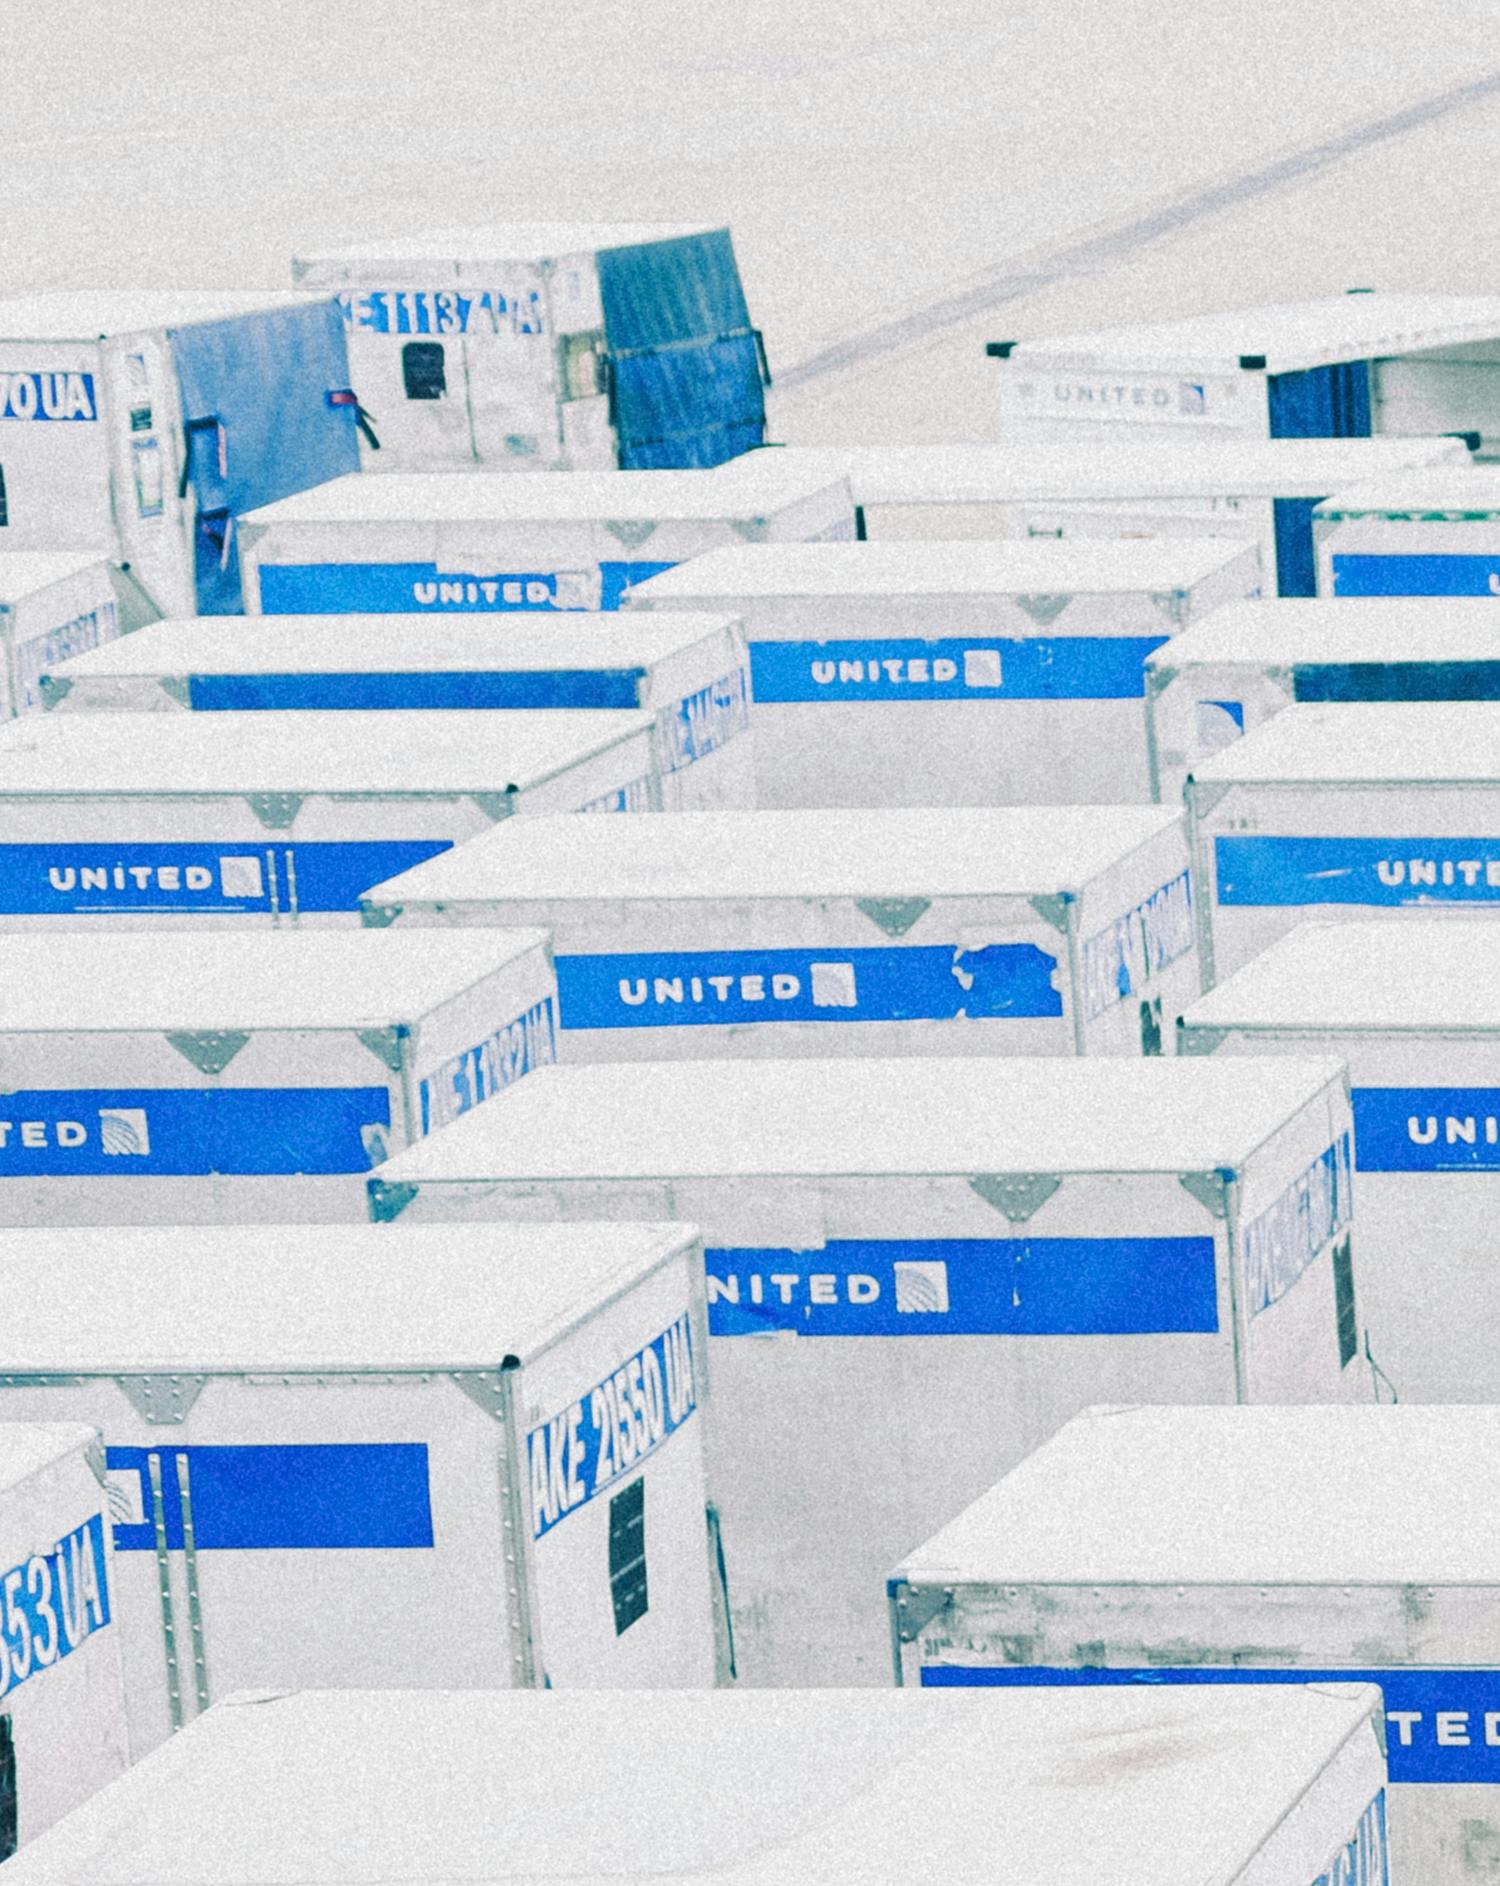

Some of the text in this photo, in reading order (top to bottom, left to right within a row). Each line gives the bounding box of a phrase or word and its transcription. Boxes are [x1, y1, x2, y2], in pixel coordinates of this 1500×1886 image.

[40, 374, 94, 420] UA
[1055, 384, 1170, 407] UNITED
[413, 583, 550, 604] UNITED
[811, 660, 957, 683] UNITED
[49, 866, 212, 890] UNITED
[619, 975, 801, 1004] UNITED
[0, 1120, 87, 1148] TED
[707, 1274, 881, 1305] NITED
[532, 1313, 697, 1534] AKE 21550 UA
[56, 1525, 104, 1648] UA
